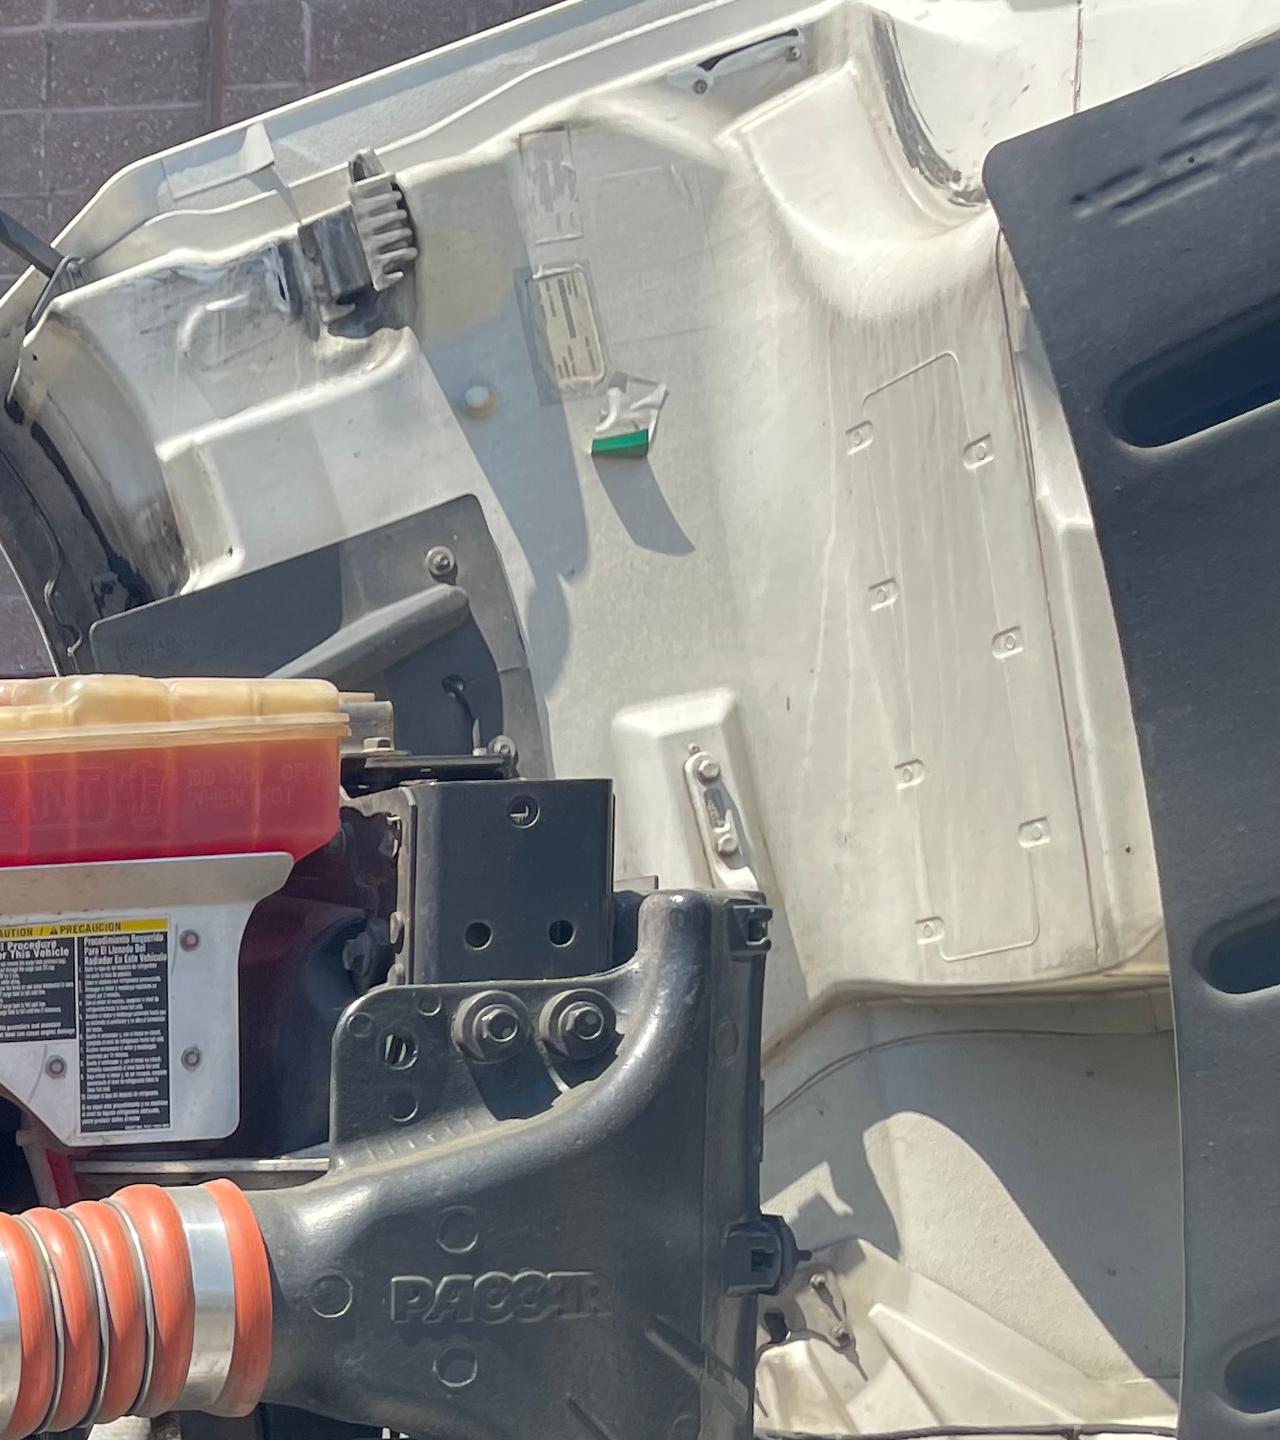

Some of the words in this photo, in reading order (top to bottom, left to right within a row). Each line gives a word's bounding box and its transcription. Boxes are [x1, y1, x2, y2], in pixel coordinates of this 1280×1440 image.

[60, 922, 122, 935] PRECAUCION
[7, 940, 57, 951] Procedure
[10, 950, 31, 960] This
[33, 947, 70, 958] Vehicle
[391, 1270, 615, 1325] PACCAR
